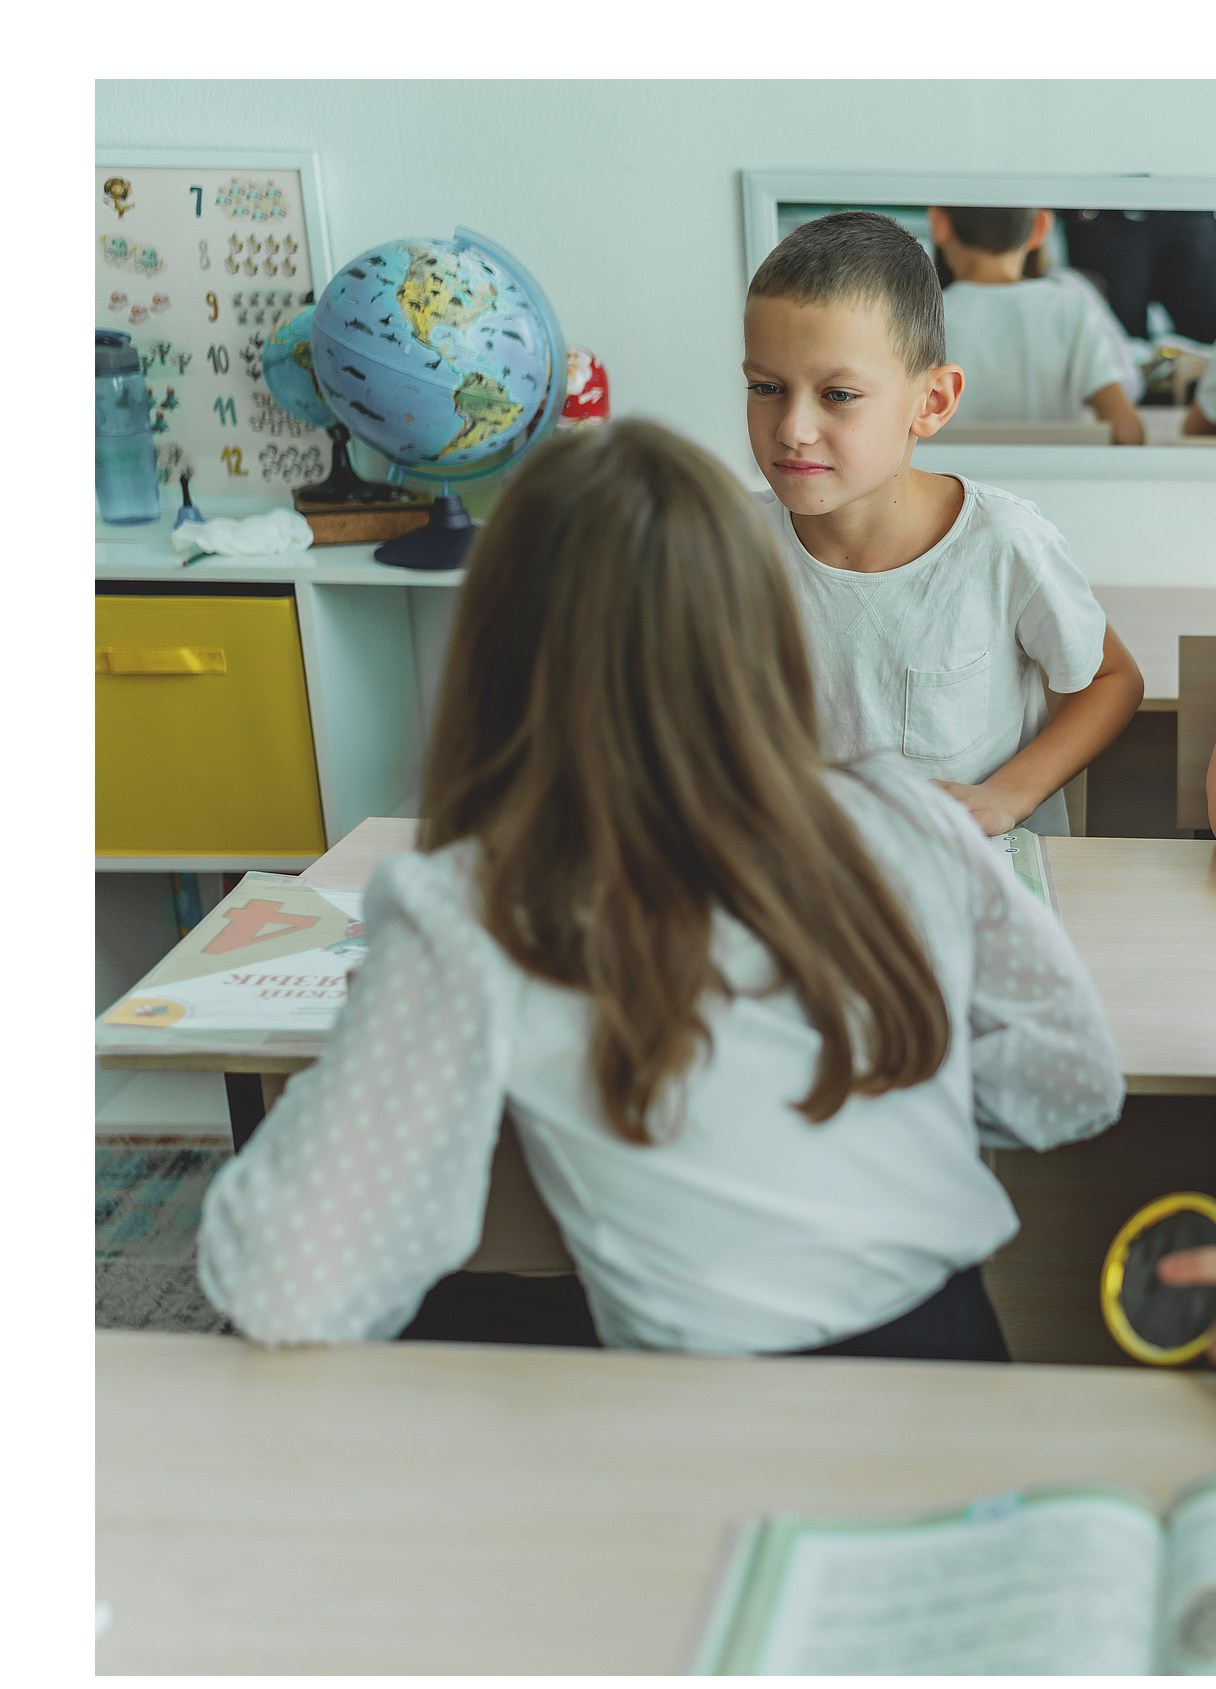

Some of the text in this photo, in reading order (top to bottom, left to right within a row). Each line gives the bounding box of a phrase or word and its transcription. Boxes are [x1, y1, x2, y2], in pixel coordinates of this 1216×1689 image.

[189, 184, 204, 218] 7
[198, 238, 212, 271] 8
[205, 290, 220, 324] 9
[206, 342, 230, 376] 10
[213, 394, 239, 427] 11
[220, 444, 246, 478] 12
[199, 898, 322, 956] 4
[222, 973, 347, 987] ЯЗЫК
